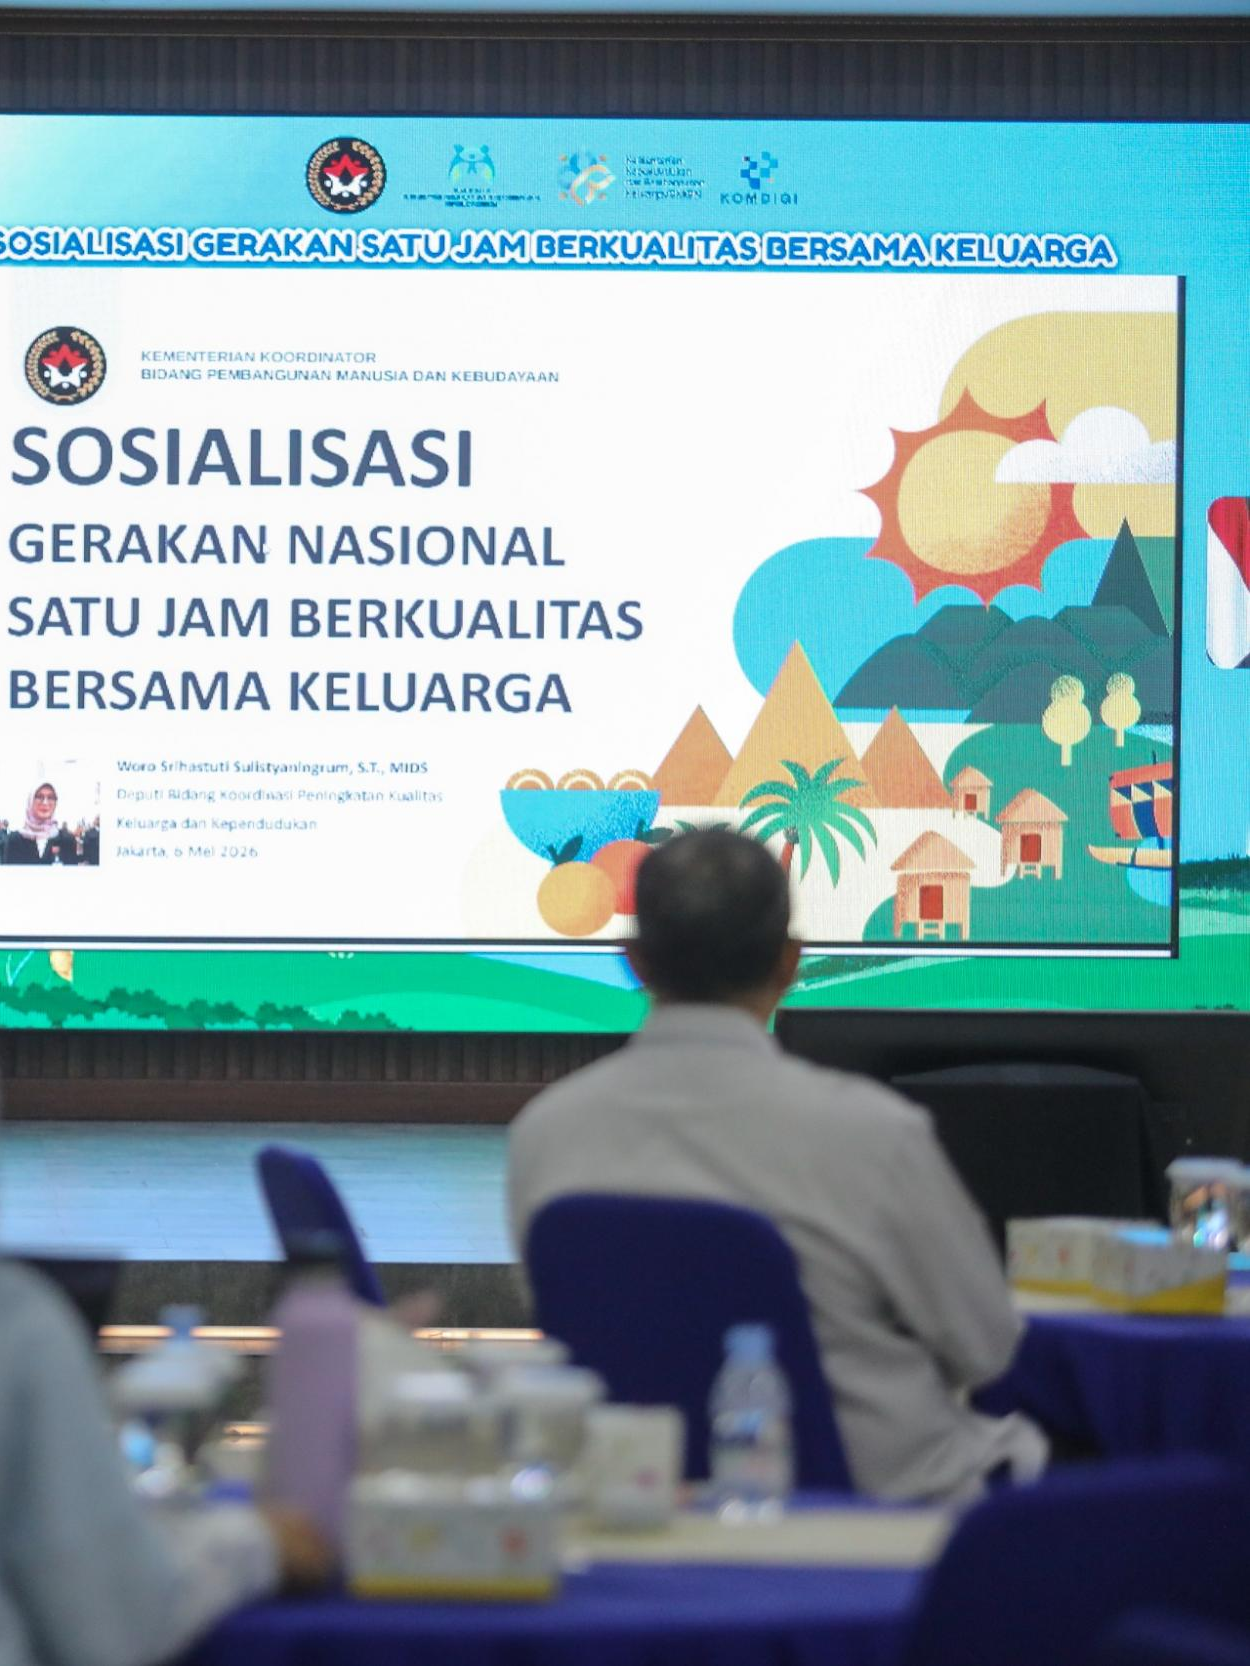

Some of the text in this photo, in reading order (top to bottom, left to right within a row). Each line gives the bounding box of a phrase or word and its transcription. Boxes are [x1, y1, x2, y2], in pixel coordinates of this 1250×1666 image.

[192, 232, 351, 258] GERAKAN
[361, 232, 446, 258] SATU
[455, 232, 527, 259] JAM
[538, 234, 756, 260] BERKUALITAS
[768, 235, 925, 263] BERSAMA
[937, 236, 1112, 265] KELUARGA
[142, 352, 375, 362] KEMENTERIAN KOORDINATOR
[141, 369, 558, 382] BIDANG PEMBANGUNAN MANUSIA DAN KEBUDAYAAN
[12, 427, 471, 488] SOSIALISASI
[9, 524, 564, 566] GERAKAN NASIONAL
[8, 597, 642, 640] SATU JAM BERKUALITAS
[10, 670, 571, 713] BERSAMA KELUARGA
[117, 761, 157, 772] Woro
[390, 762, 428, 773] MIDS
[182, 818, 206, 829] dan
[221, 846, 258, 858] 2026
